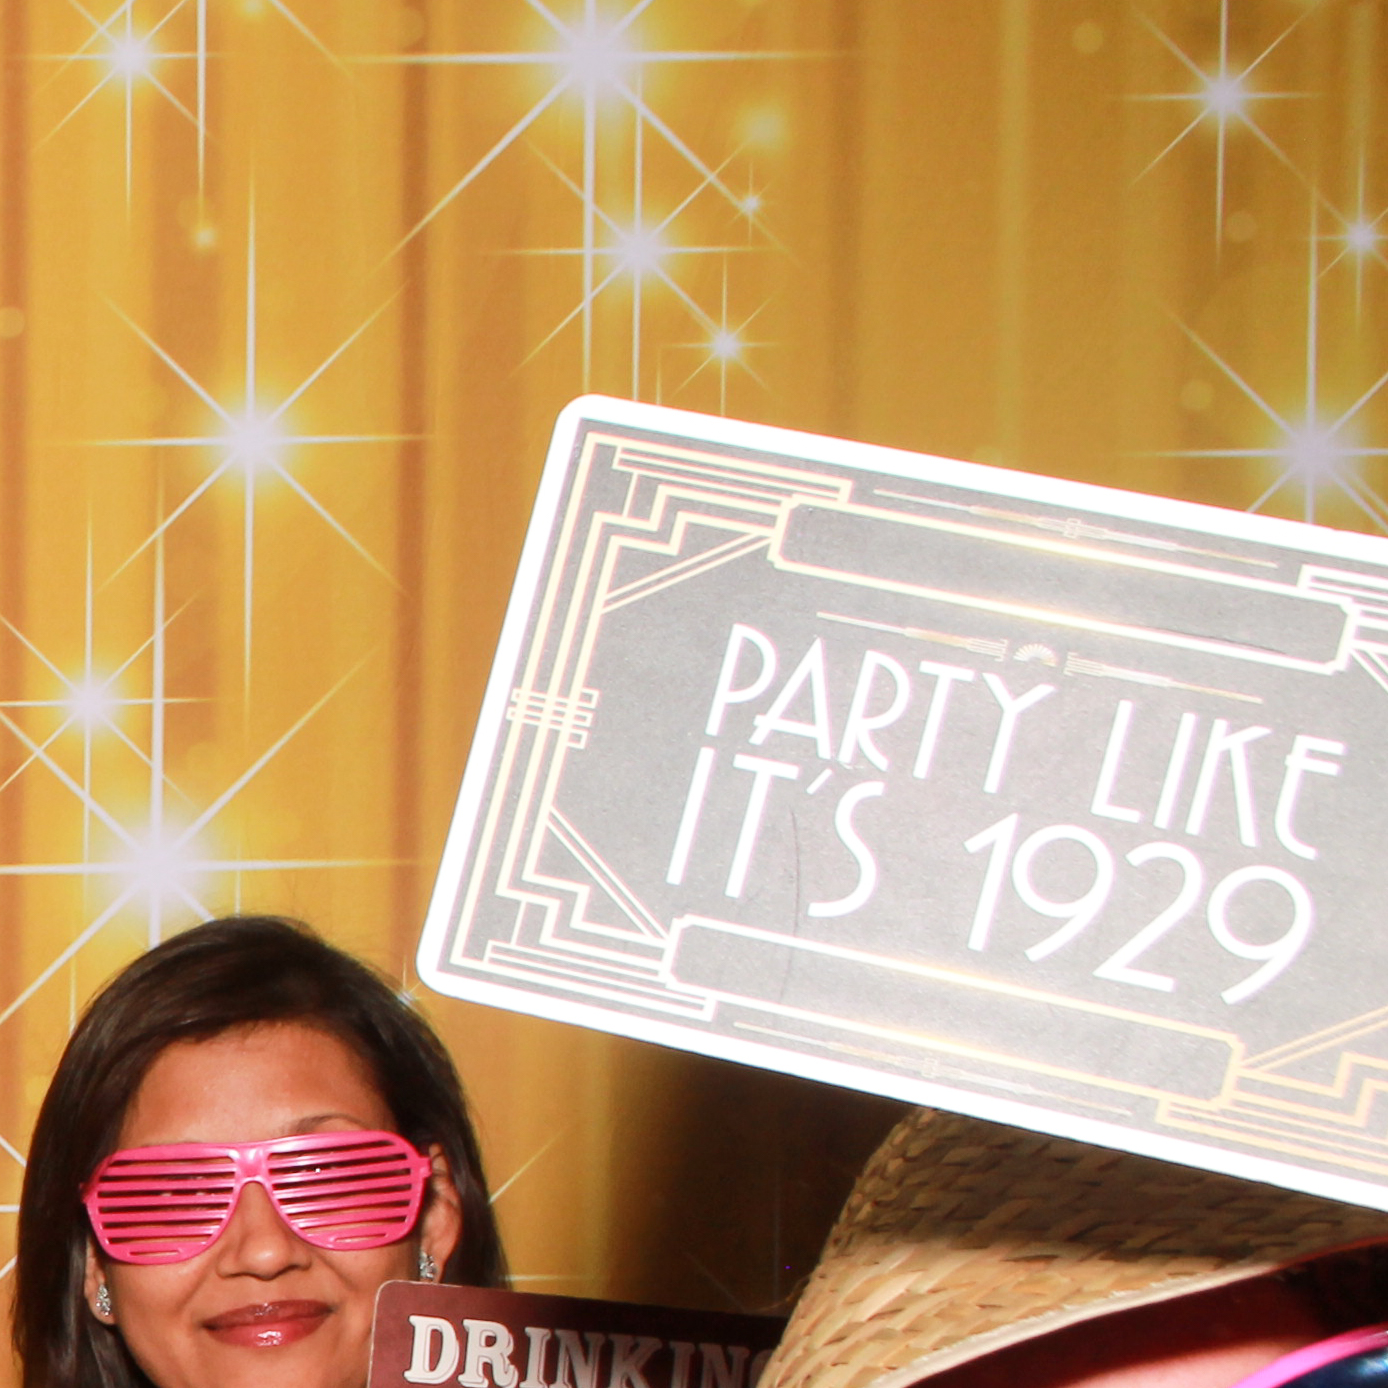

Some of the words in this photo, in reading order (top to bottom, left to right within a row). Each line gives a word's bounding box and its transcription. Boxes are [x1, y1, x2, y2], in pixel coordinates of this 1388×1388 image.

[706, 623, 1055, 795] PARTY
[1090, 700, 1346, 860] LIKE
[666, 746, 885, 918] IT'S
[964, 812, 1316, 1005] 1929
